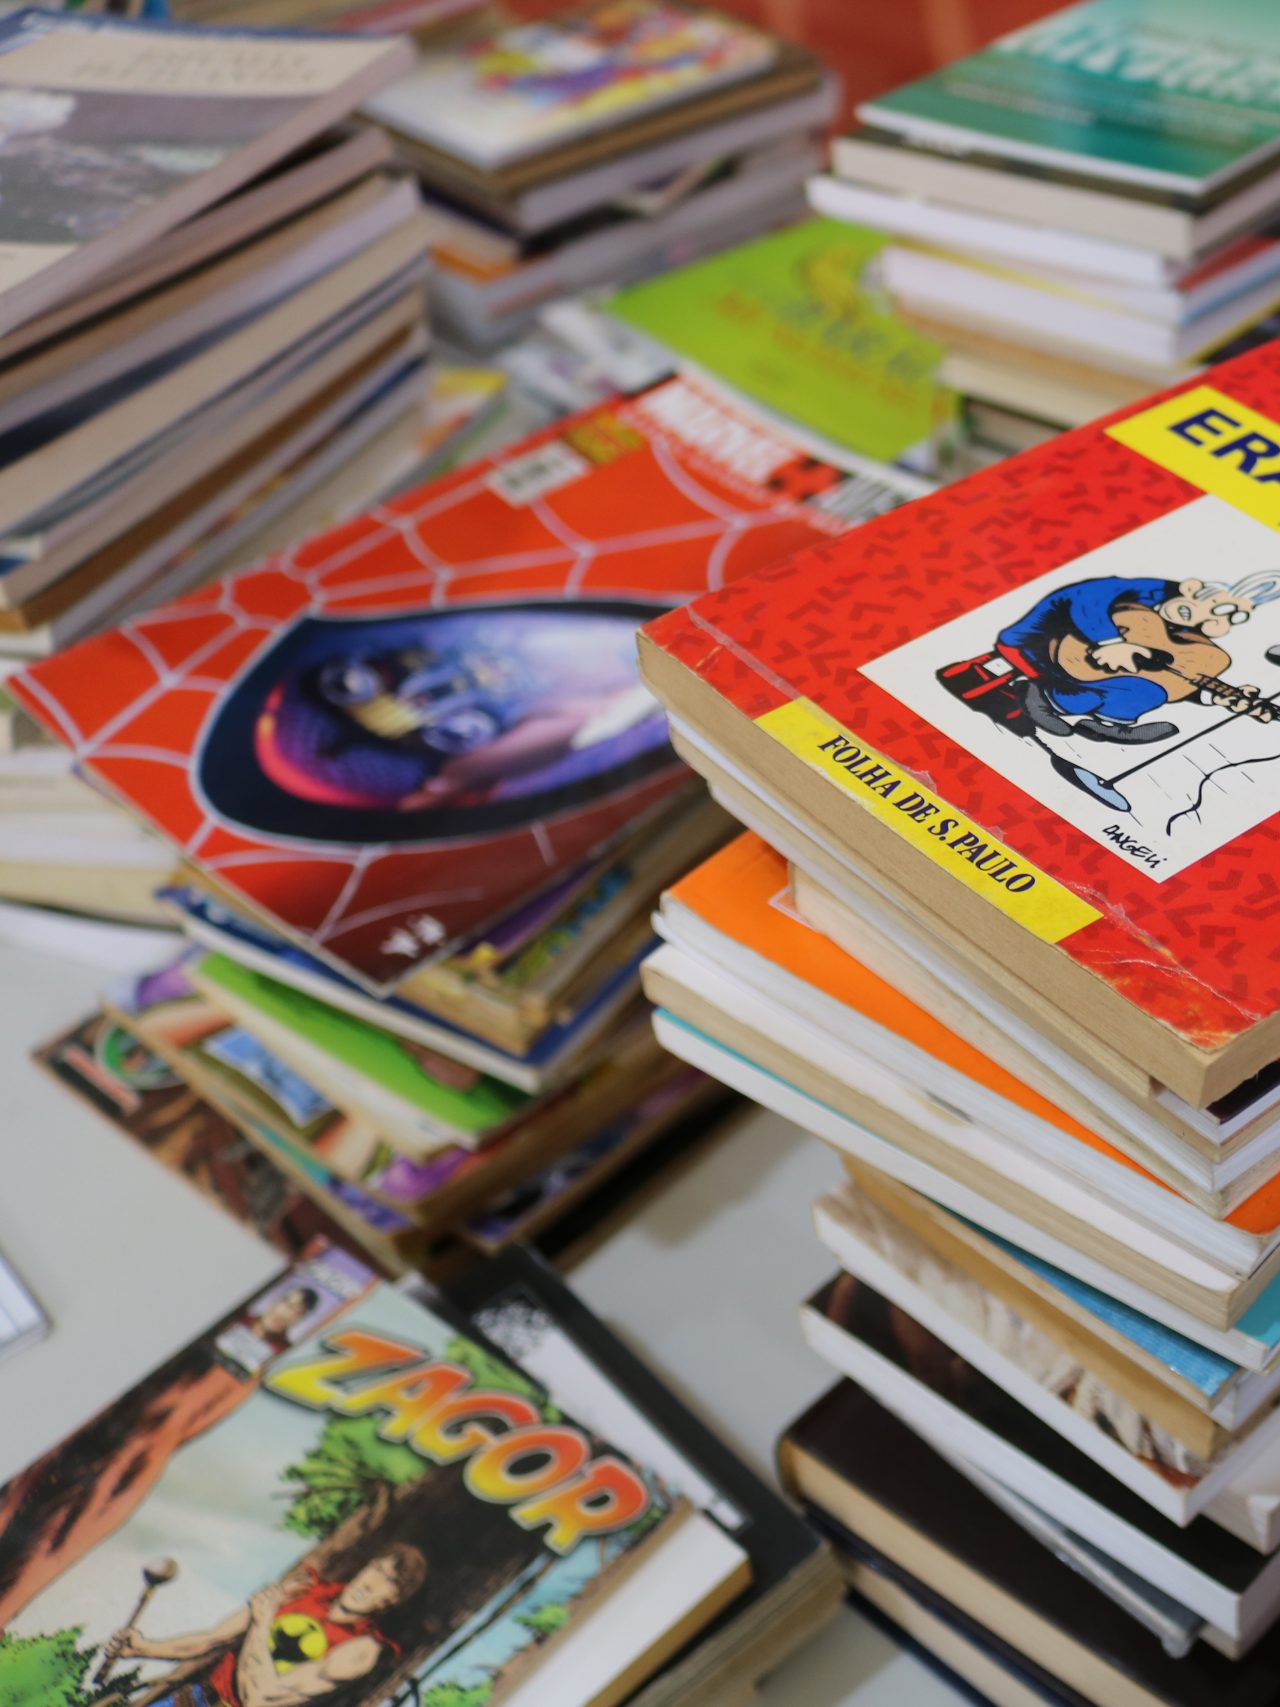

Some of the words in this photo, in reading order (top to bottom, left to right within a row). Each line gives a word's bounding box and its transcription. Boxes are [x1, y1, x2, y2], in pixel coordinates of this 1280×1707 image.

[817, 734, 902, 799] FOLHA
[892, 791, 930, 825] DE
[264, 1327, 648, 1558] ZAGOR
